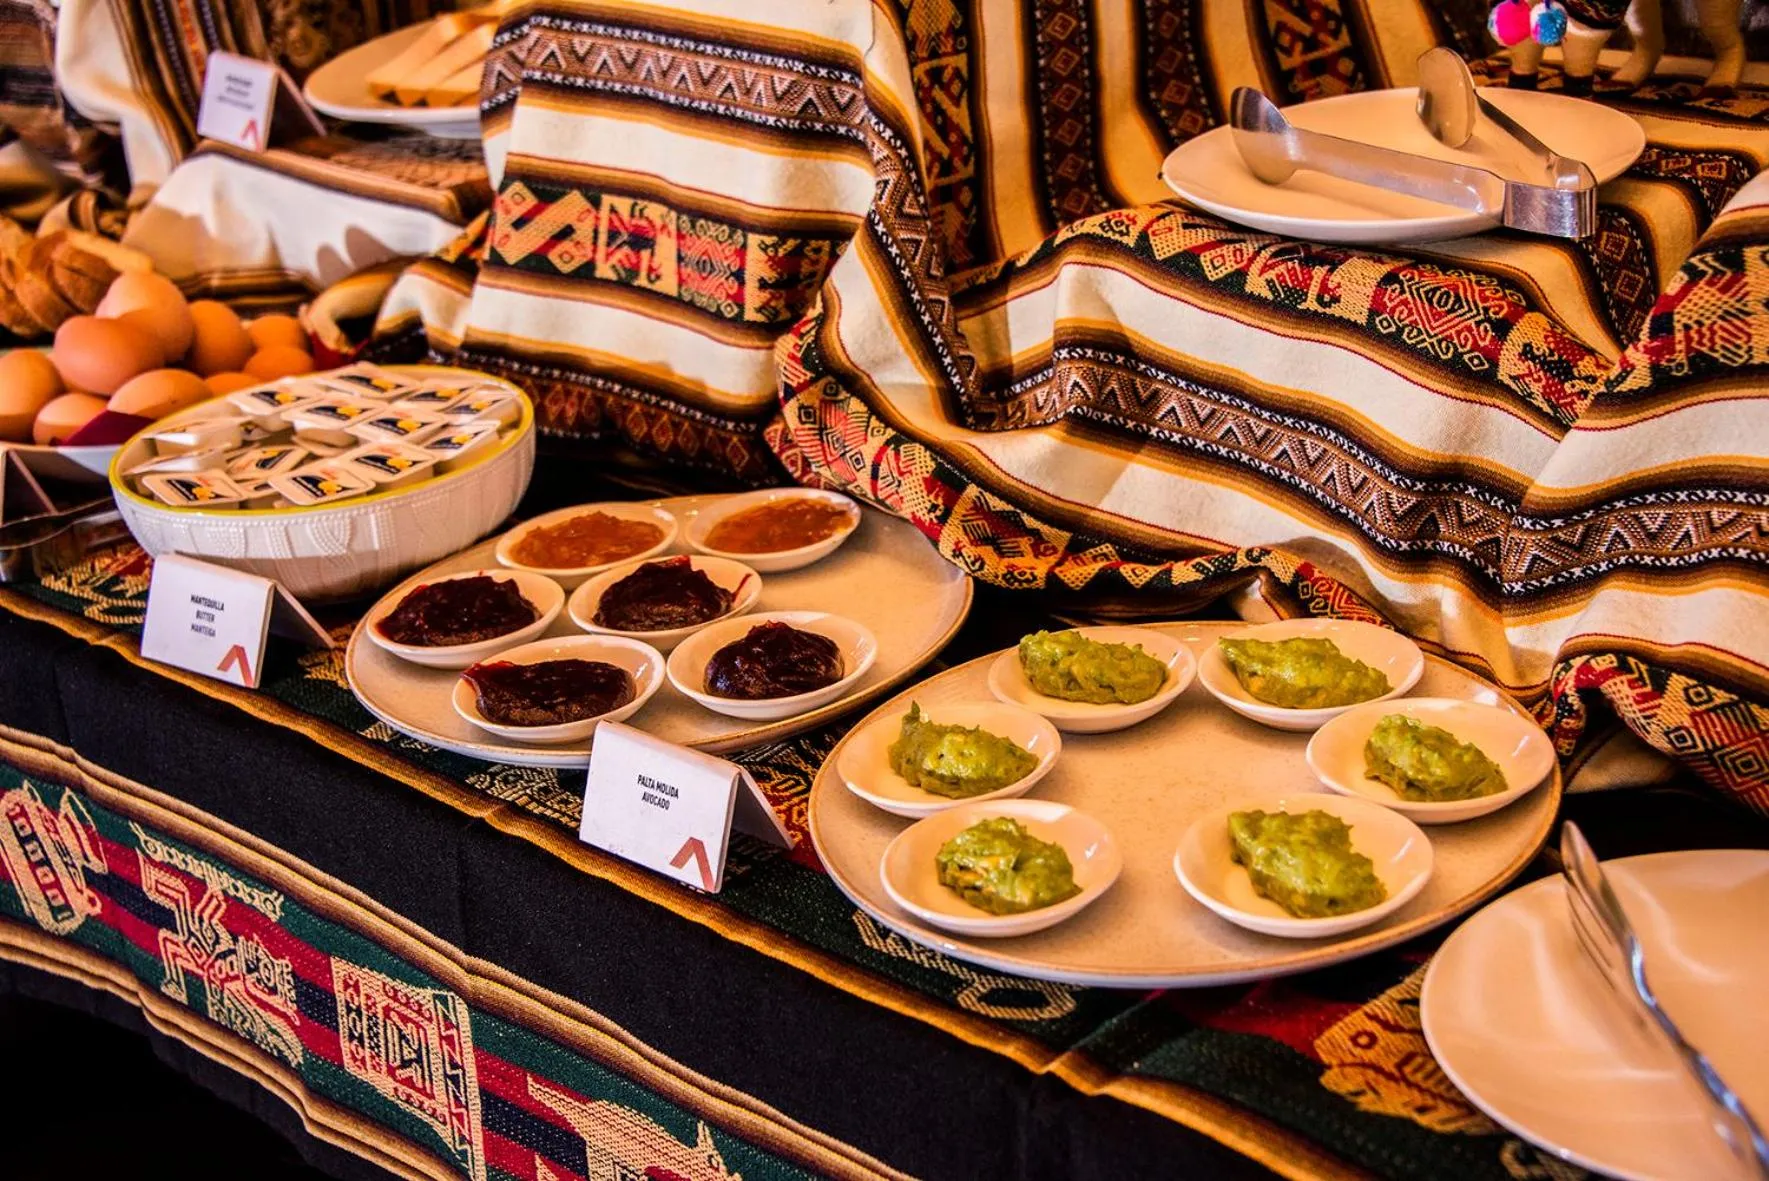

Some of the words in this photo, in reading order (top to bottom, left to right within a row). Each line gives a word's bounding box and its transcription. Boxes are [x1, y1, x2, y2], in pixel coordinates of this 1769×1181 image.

[191, 594, 224, 611] MANTEQUILLA
[196, 610, 215, 622] BUTTER
[637, 774, 655, 790] PALTA
[656, 781, 679, 799] MOLIDA
[642, 792, 670, 810] AVOCADO
